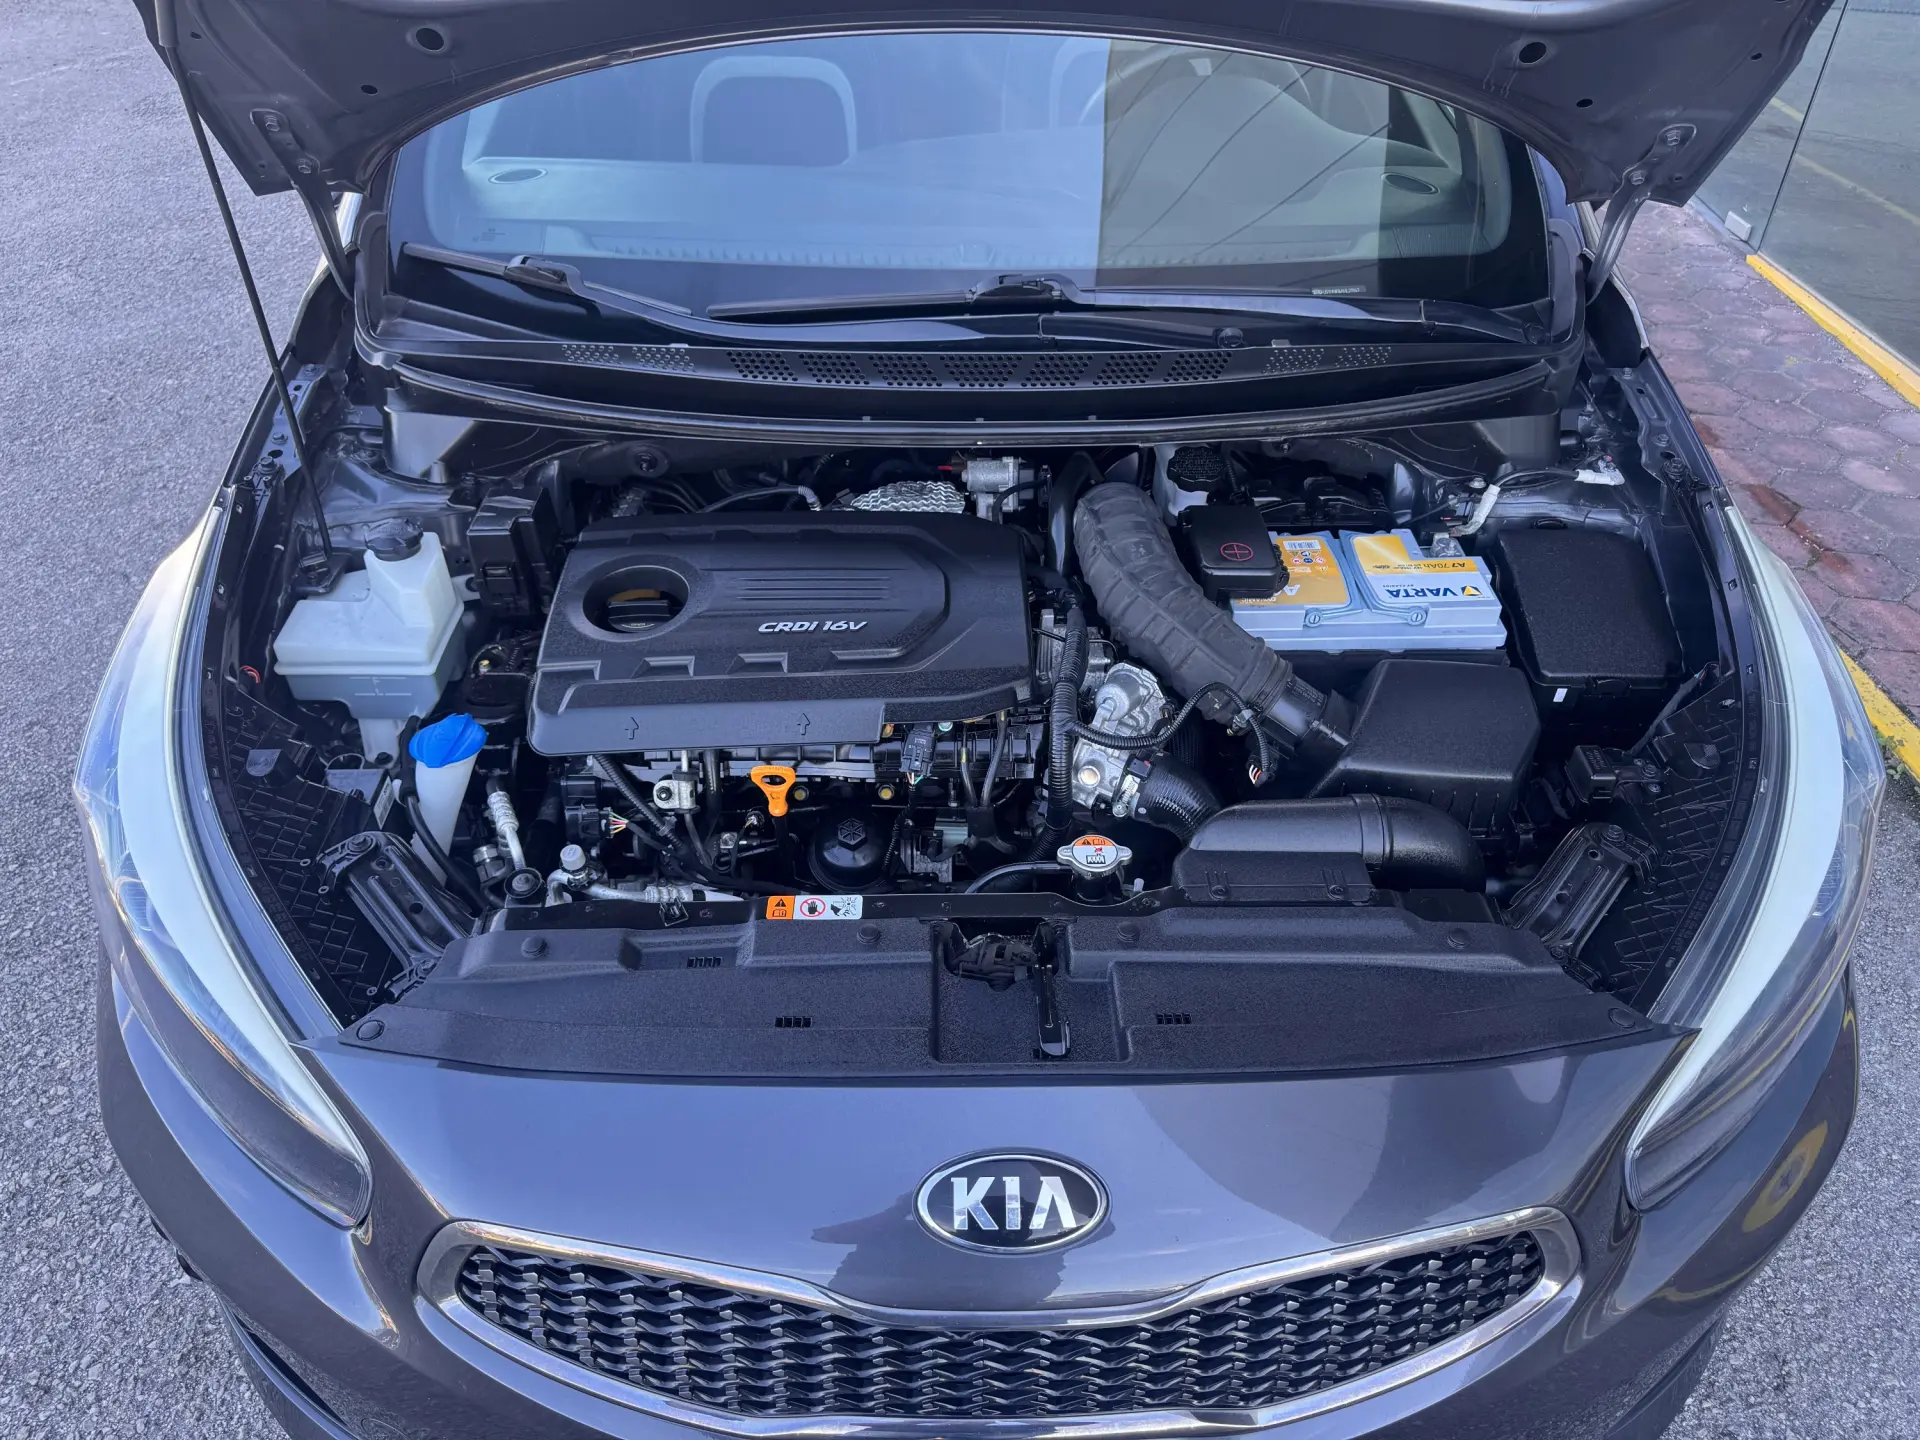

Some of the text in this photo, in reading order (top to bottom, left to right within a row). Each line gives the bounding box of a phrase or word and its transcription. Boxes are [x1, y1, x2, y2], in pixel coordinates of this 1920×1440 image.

[1385, 587, 1458, 599] VARTA
[758, 620, 868, 632] CRDI 16V
[950, 1176, 1078, 1231] KIA
